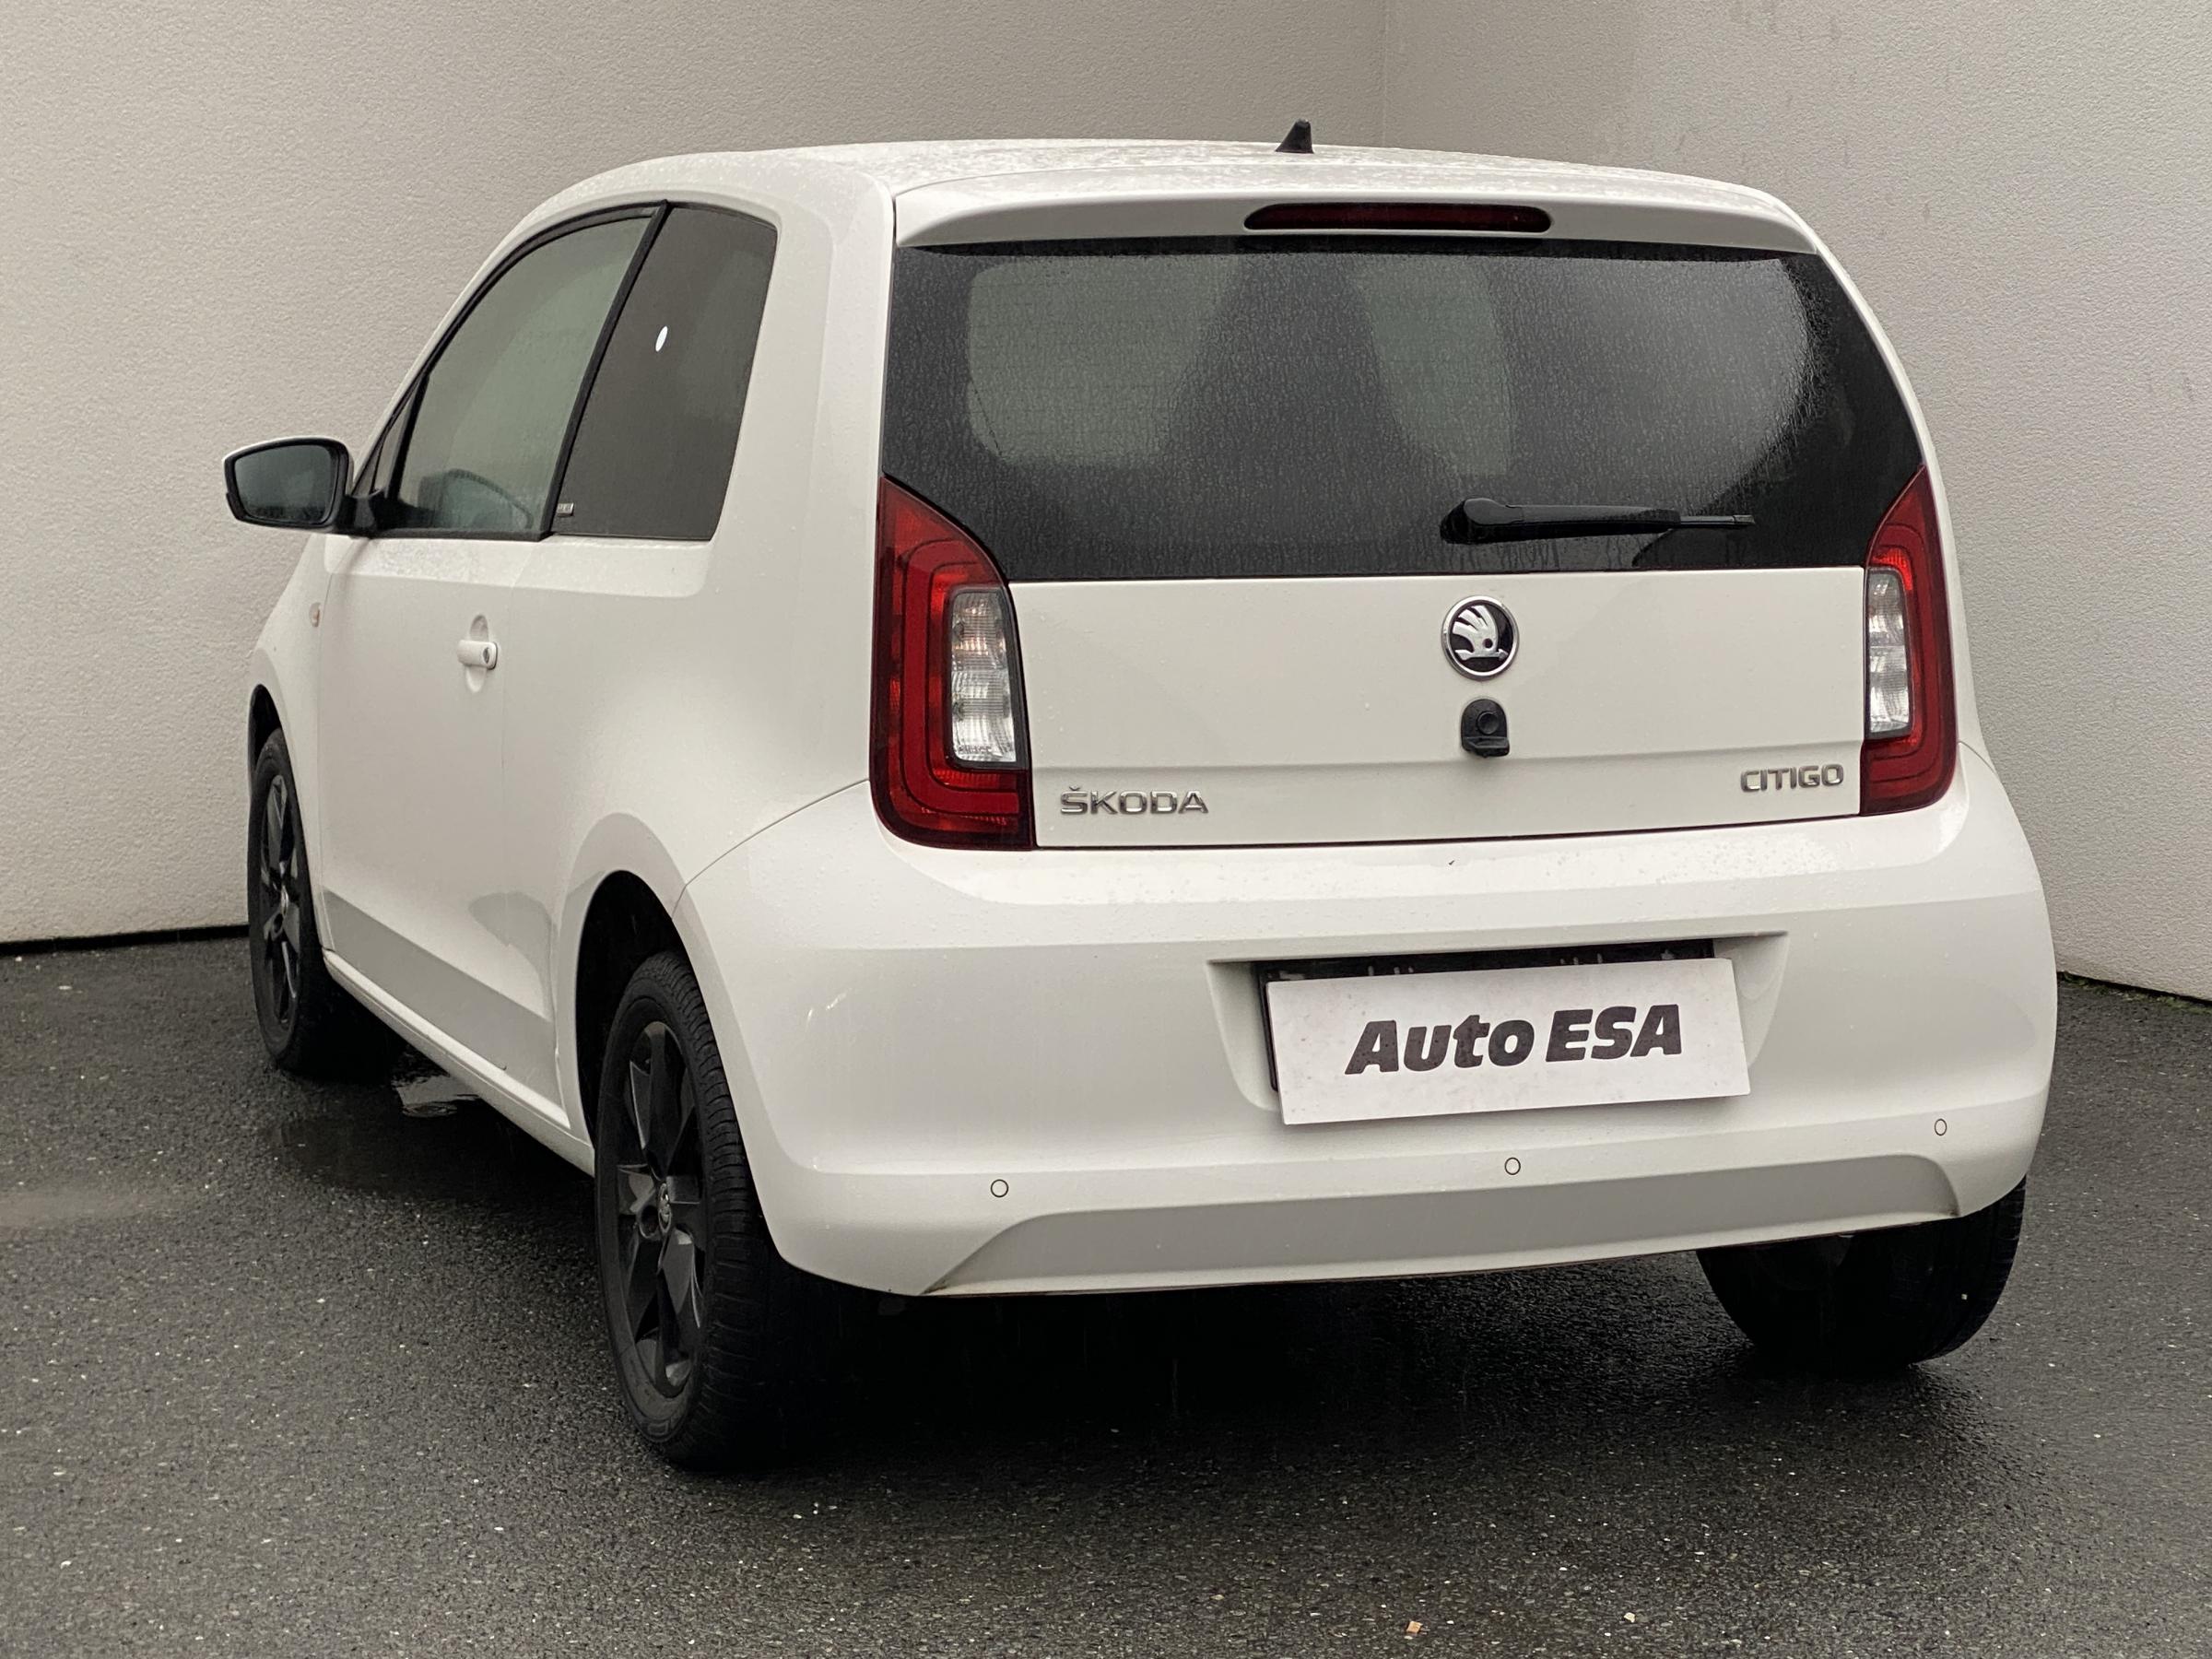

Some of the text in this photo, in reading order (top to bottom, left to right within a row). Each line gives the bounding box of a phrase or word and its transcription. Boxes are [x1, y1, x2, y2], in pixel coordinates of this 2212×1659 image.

[1740, 763, 1844, 793] CITIGO
[1060, 786, 1209, 815] ŠKODA
[1345, 1004, 1682, 1075] Auto ESA
